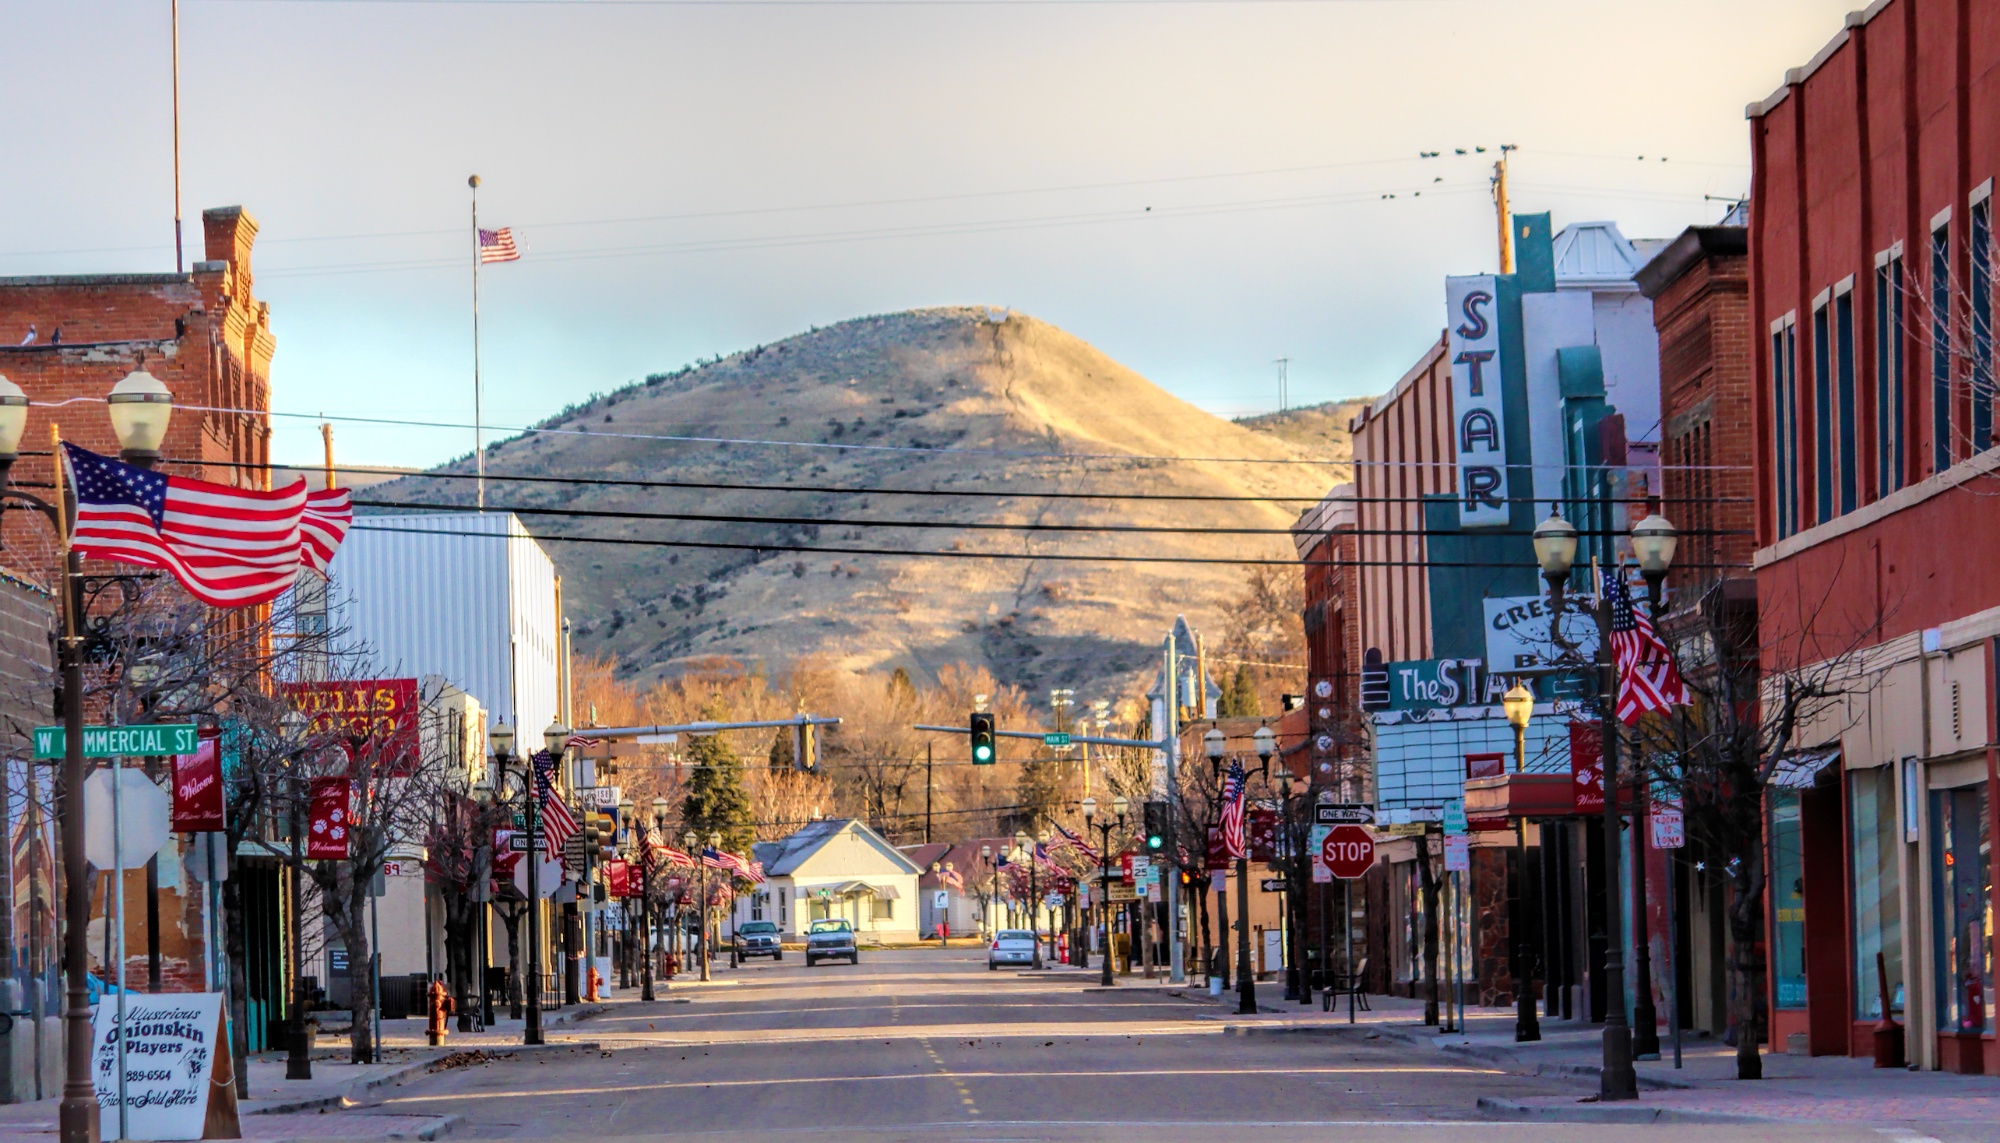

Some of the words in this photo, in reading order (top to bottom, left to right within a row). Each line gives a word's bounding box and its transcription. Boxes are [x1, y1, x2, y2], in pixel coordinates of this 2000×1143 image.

[1455, 289, 1505, 513] STAR
[1399, 669, 1439, 701] The
[38, 732, 53, 754] W
[62, 729, 166, 753] MMERCIAL
[175, 729, 195, 751] ST
[179, 774, 214, 802] Welcome
[1322, 810, 1339, 818] ONE
[1341, 809, 1360, 818] WAY
[1326, 842, 1371, 861] STOP
[1134, 868, 1147, 877] 25
[112, 1006, 201, 1024] Illustrious
[105, 1020, 204, 1044] Onionskin
[126, 1040, 184, 1056] Players
[134, 1089, 168, 1109] Sold
[164, 1089, 198, 1108] Here
